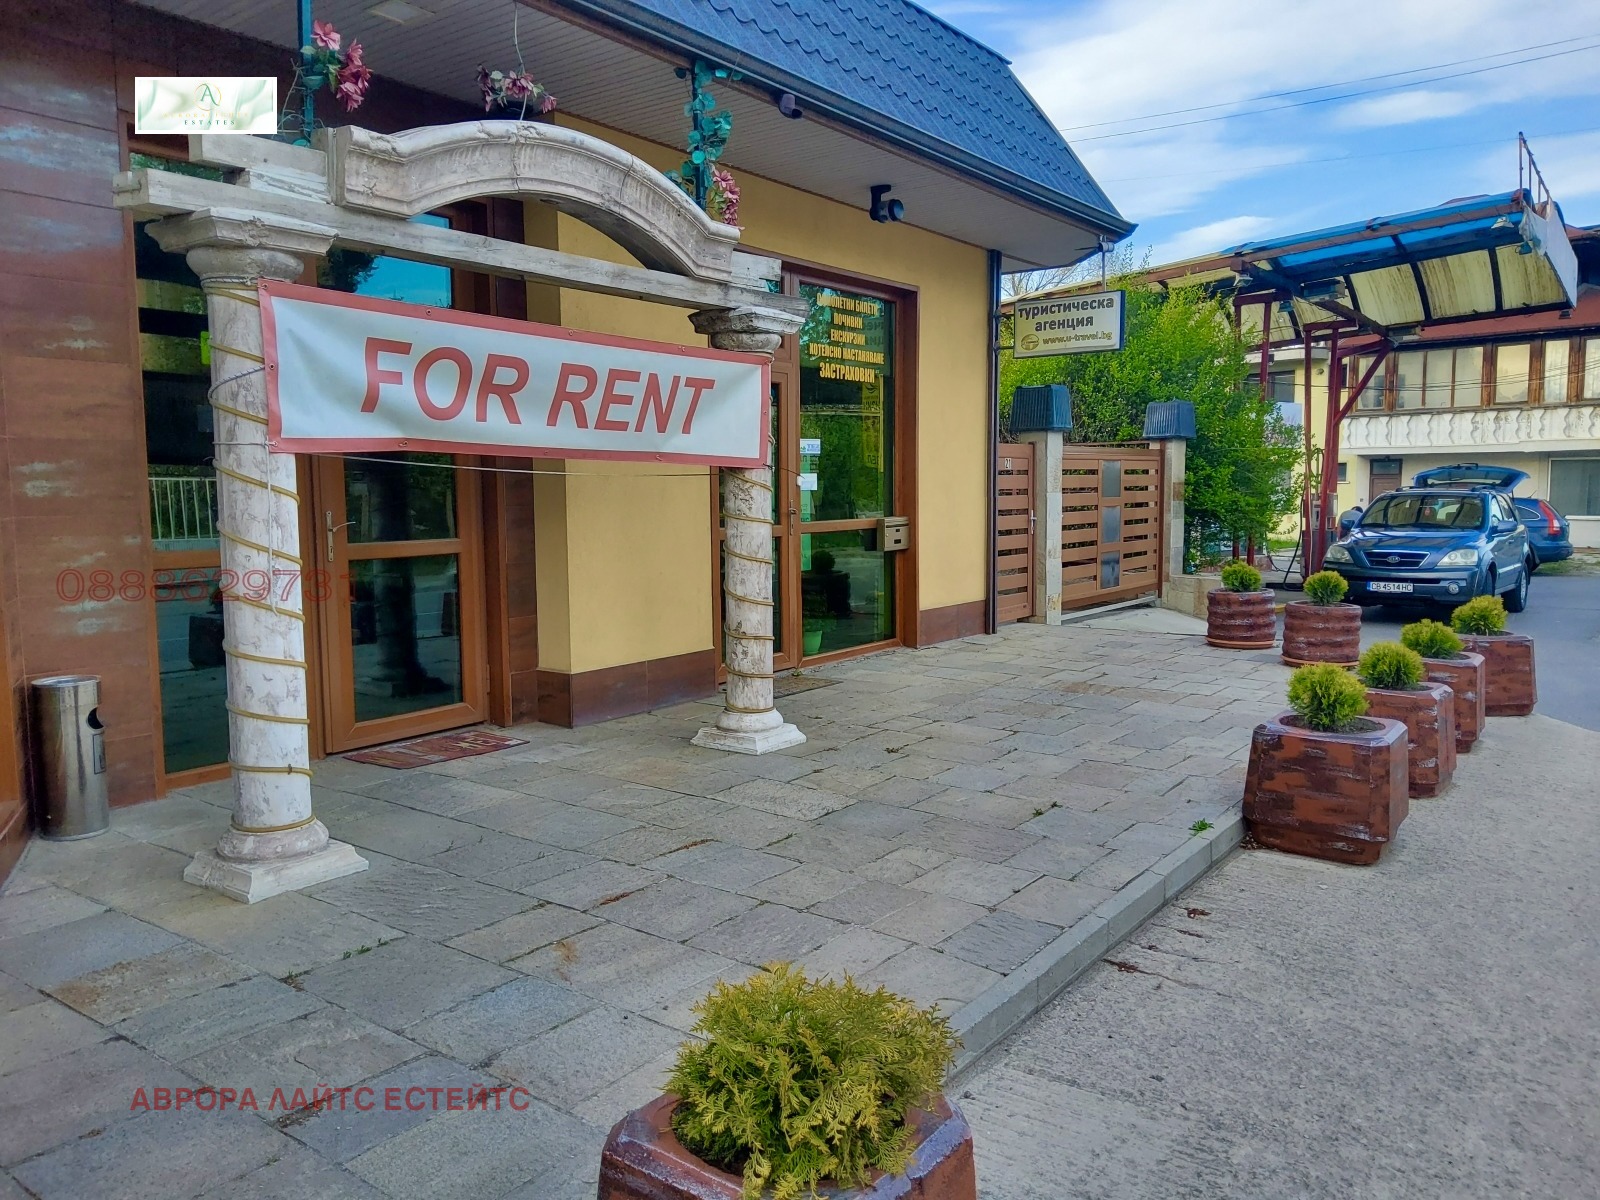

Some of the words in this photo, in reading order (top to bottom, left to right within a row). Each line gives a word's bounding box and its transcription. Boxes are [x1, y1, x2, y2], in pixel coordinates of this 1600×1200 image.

[1018, 297, 1115, 320] туристическа
[833, 312, 863, 329] ПОЧИВКИ
[1035, 316, 1094, 332] агенция
[819, 362, 875, 383] ЗАСТРАХОВКИ
[360, 336, 530, 425] FOR
[546, 362, 716, 435] RENT
[1005, 458, 1011, 469] 21
[1382, 582, 1400, 591] 4514
